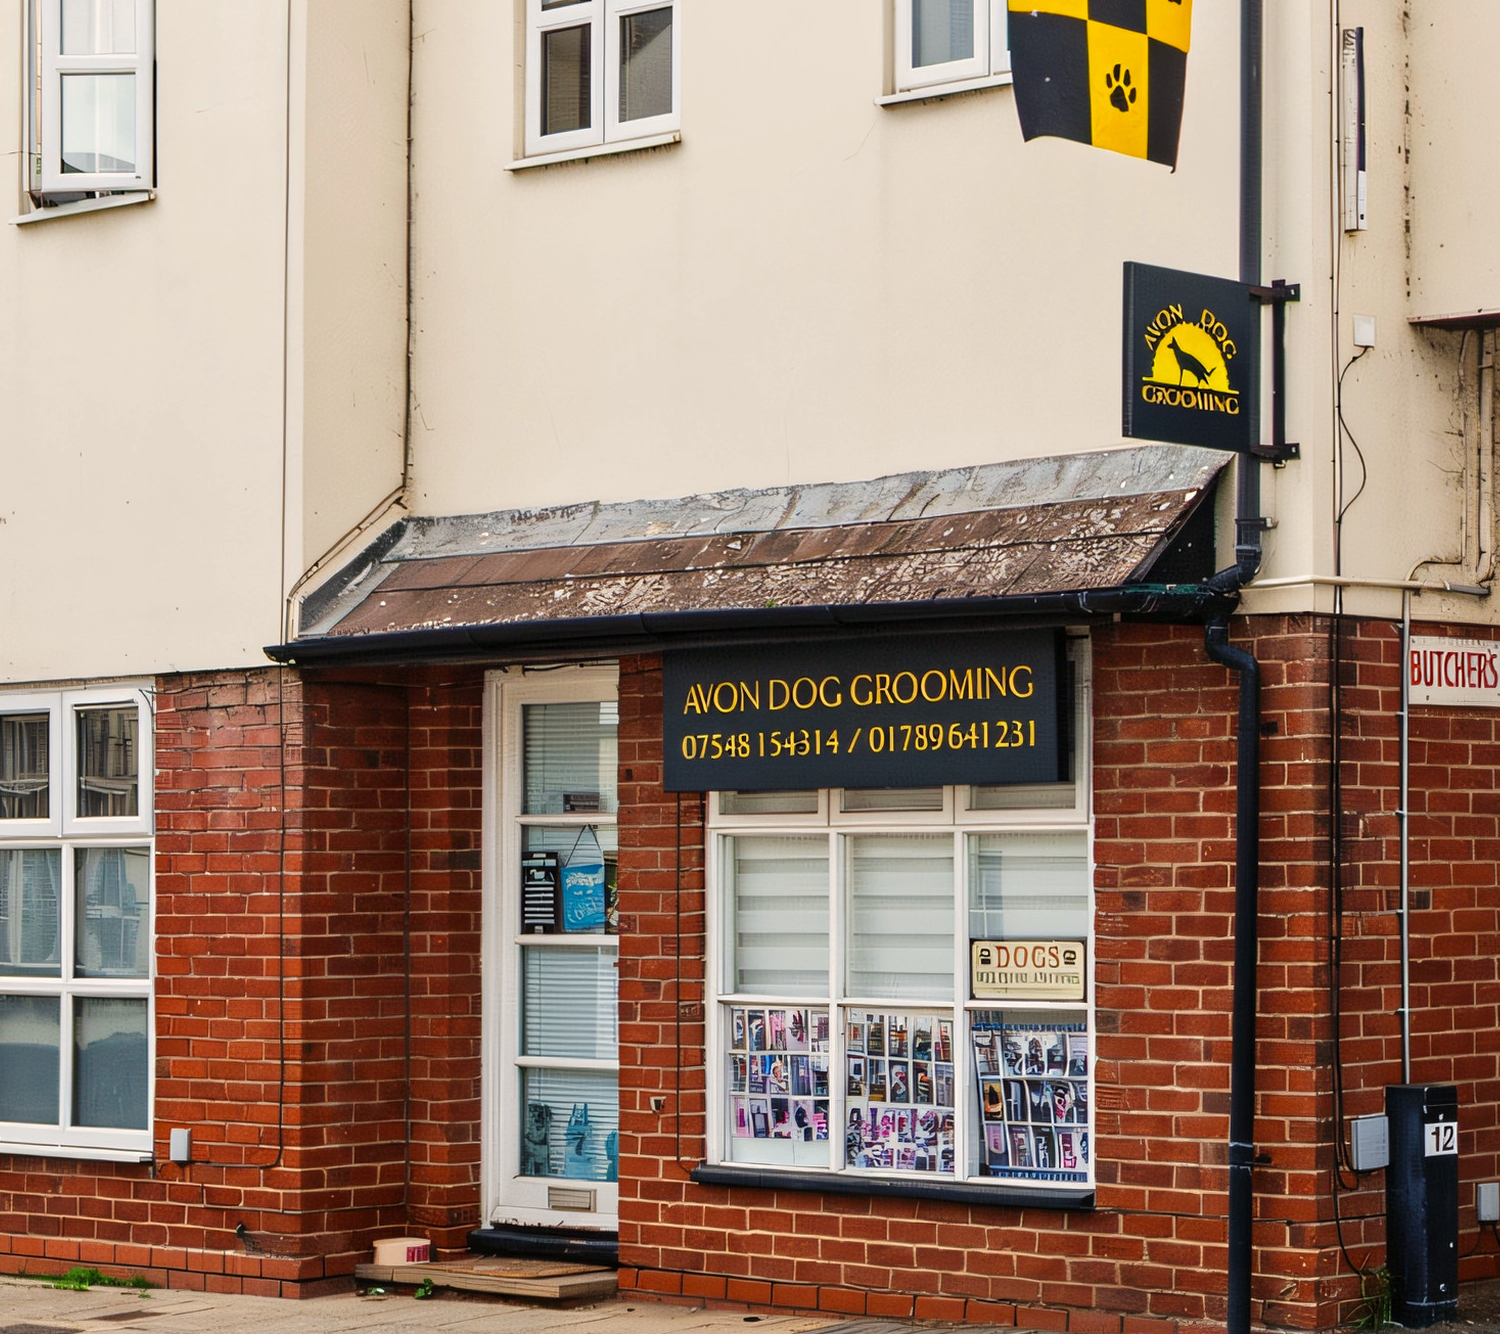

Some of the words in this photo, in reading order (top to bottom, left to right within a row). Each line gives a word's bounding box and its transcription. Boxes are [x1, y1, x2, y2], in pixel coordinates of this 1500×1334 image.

[683, 680, 760, 715] AVON
[769, 676, 843, 710] DOG
[850, 665, 1034, 706] GROOMING
[681, 733, 750, 760] 07548
[758, 729, 839, 757] 154314
[995, 945, 1060, 969] DOGS
[1431, 1125, 1454, 1152] 12
